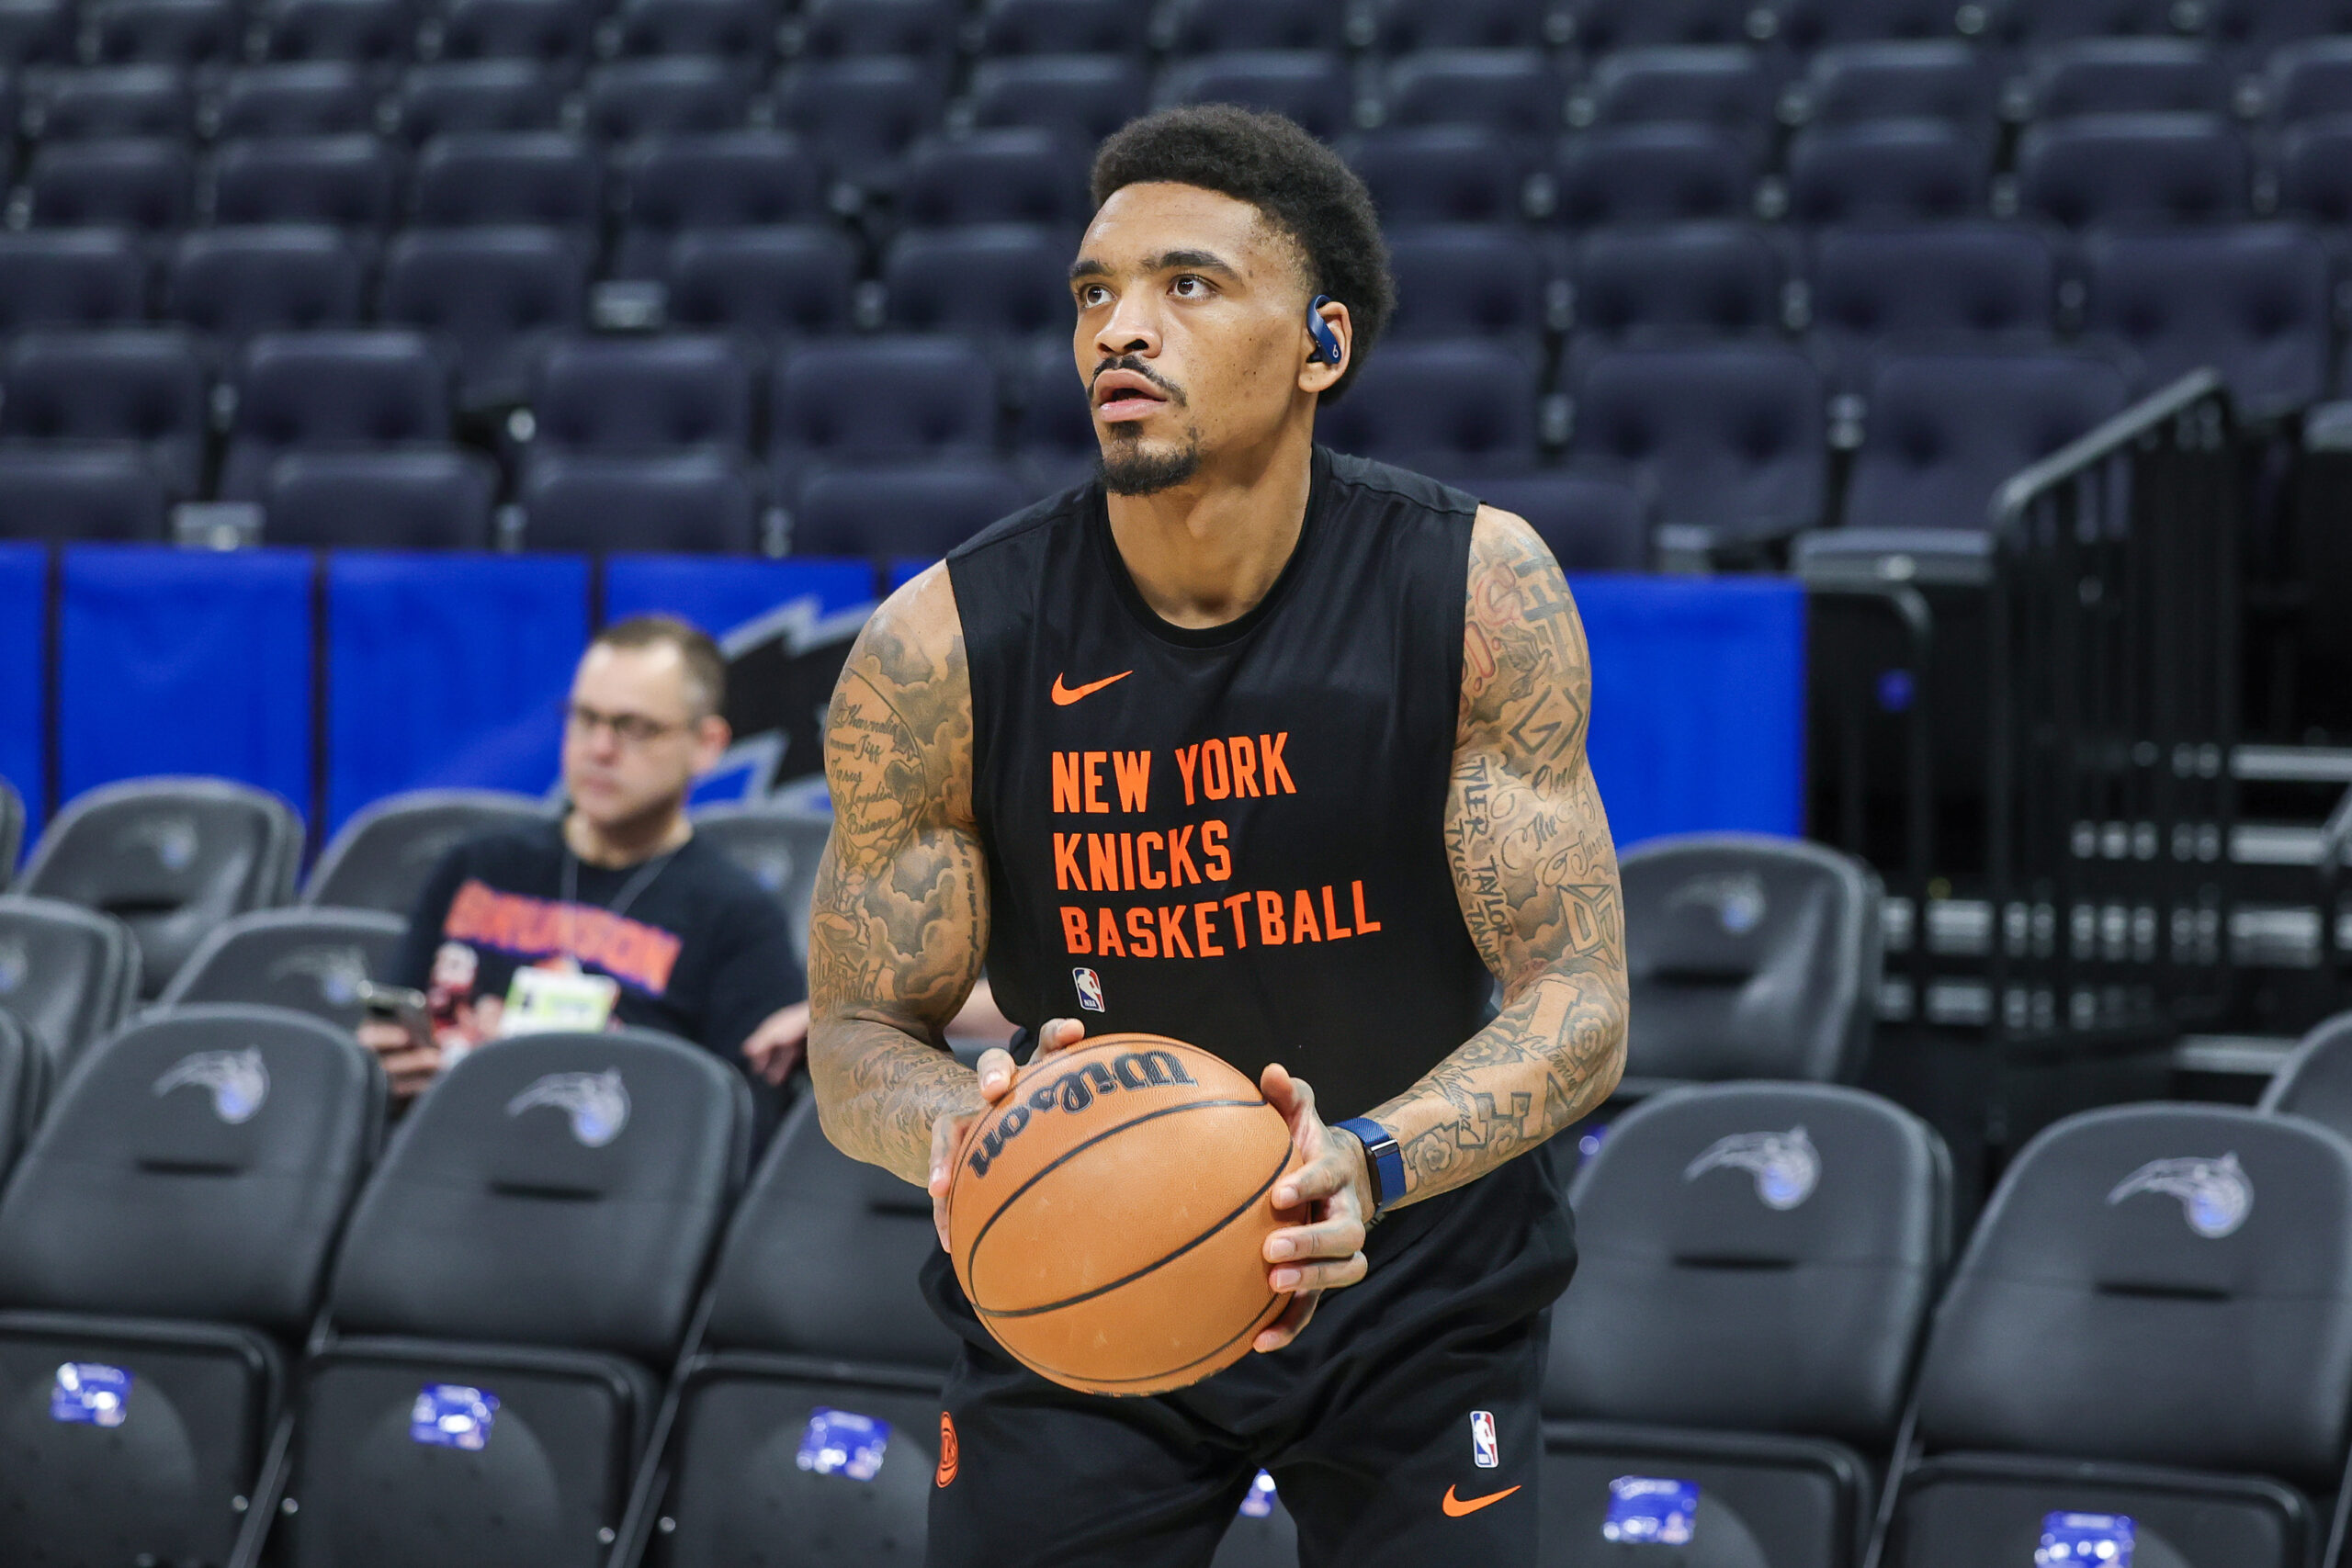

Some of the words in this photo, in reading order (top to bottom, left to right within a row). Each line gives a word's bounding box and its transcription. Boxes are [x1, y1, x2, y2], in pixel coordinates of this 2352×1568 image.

[1052, 750, 1151, 813] NEW
[1175, 732, 1297, 806] YORK
[1452, 756, 1494, 846] TYLER
[1053, 819, 1232, 892] KNICKS
[1445, 818, 1471, 887] TYUS
[1059, 880, 1381, 958] BASKETBALL
[1472, 854, 1514, 951] TAYLOR
[967, 1050, 1198, 1179] Wilson
